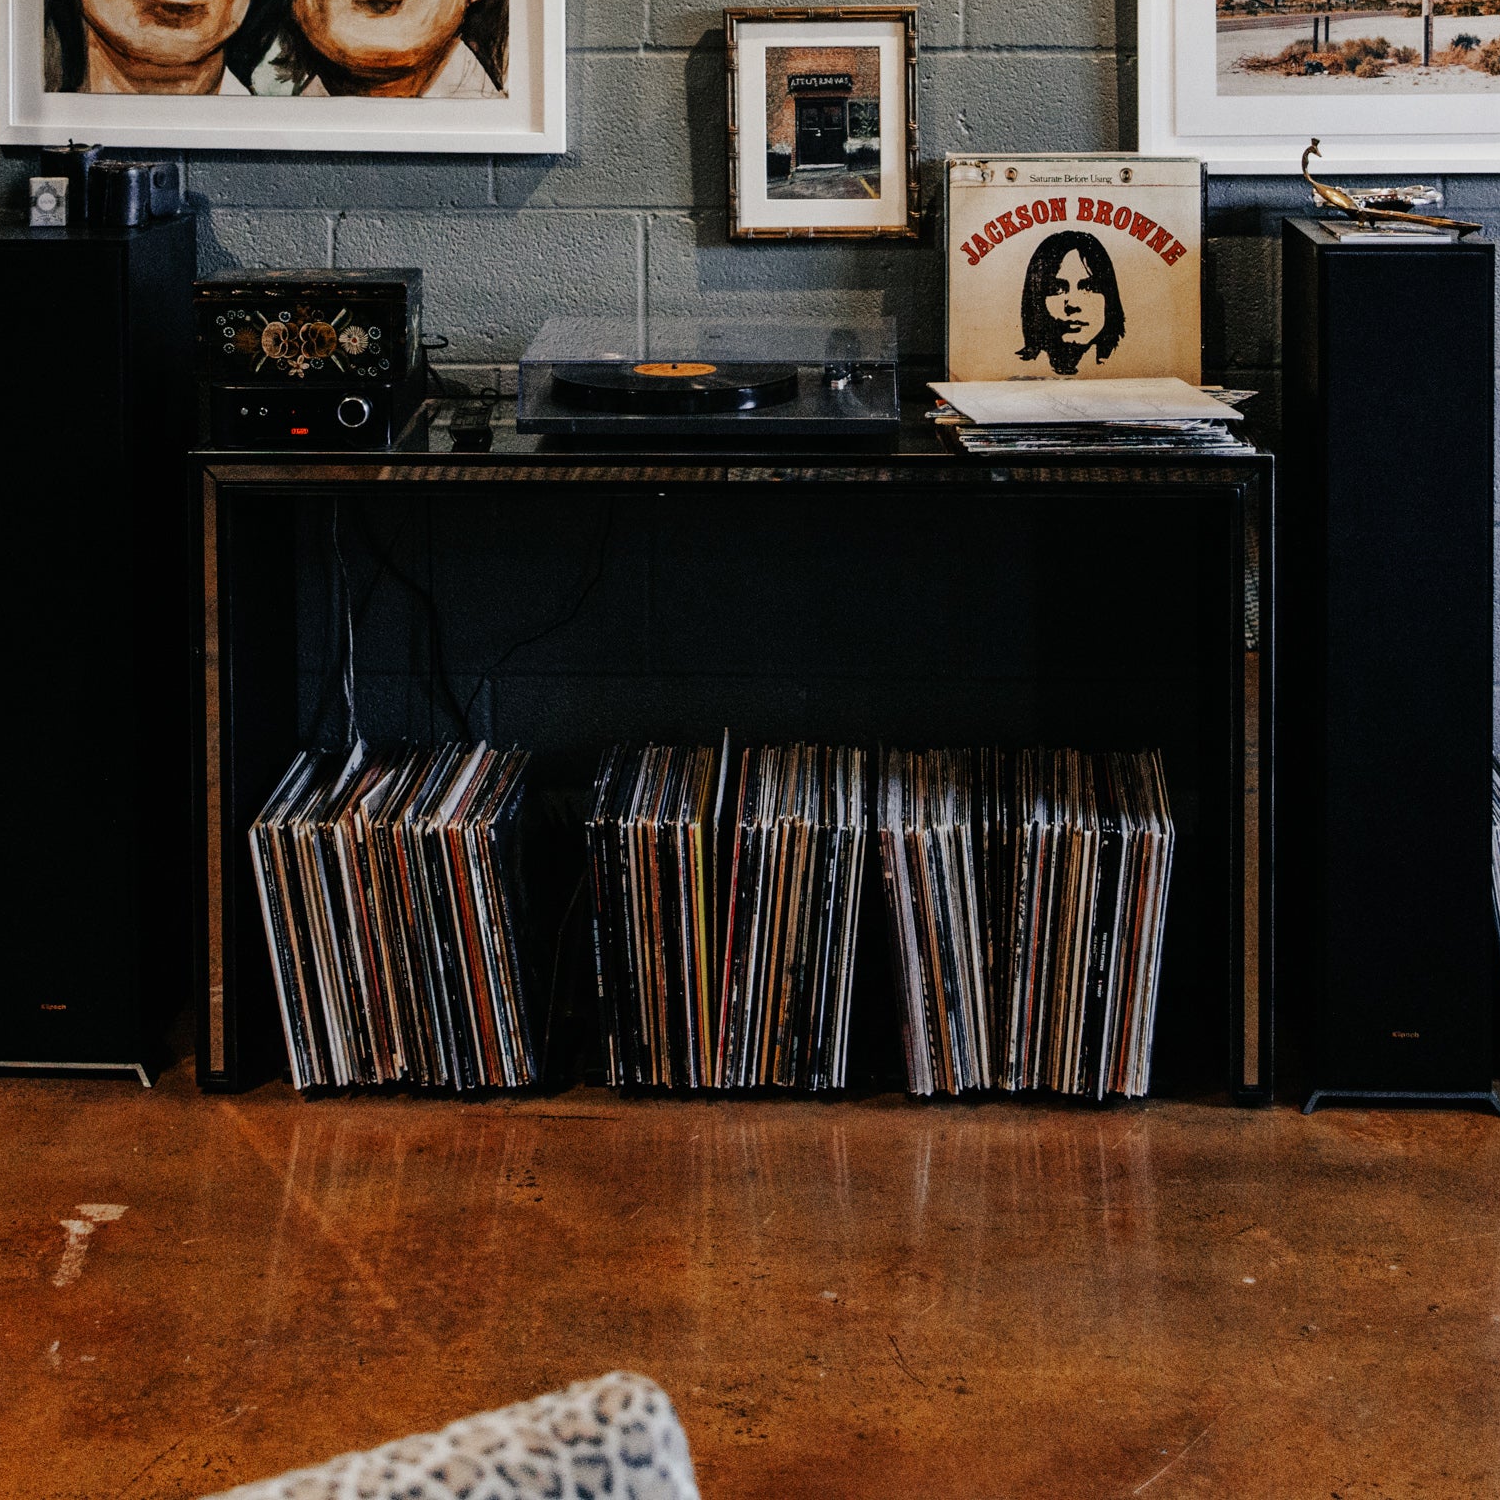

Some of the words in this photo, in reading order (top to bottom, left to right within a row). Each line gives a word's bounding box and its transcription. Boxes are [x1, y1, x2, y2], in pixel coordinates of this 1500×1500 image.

[1028, 174, 1063, 184] Saturate
[1064, 174, 1089, 184] Before
[1090, 174, 1113, 185] Using
[959, 196, 1068, 267] JACKSON
[1076, 196, 1188, 267] BROWNE
